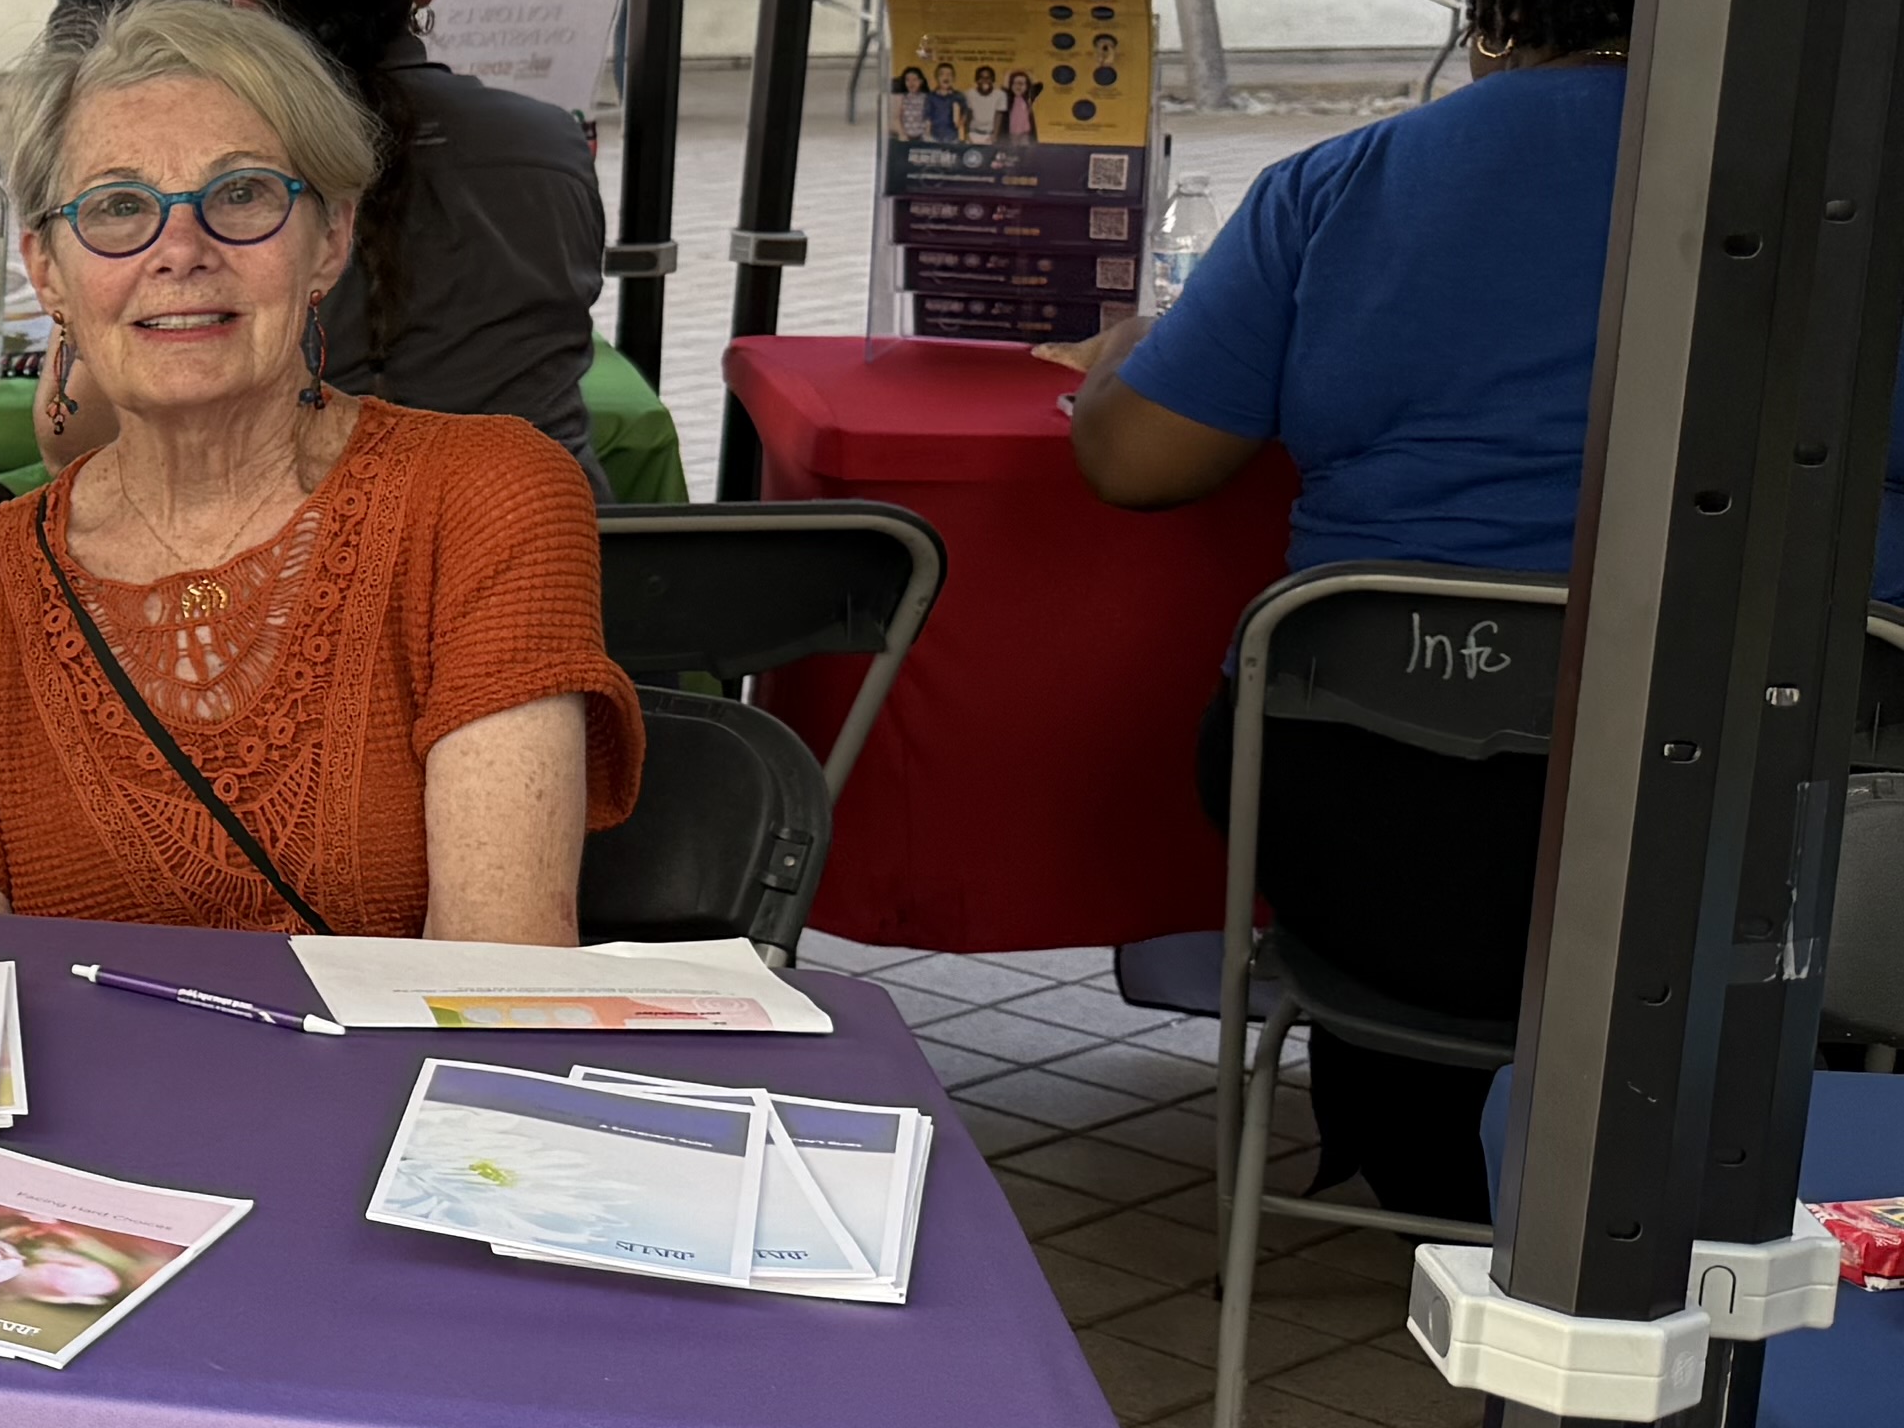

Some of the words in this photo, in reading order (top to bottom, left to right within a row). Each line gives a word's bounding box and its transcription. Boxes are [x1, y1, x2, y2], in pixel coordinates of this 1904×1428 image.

[1405, 612, 1512, 681] Info
[16, 1191, 67, 1209] Facing
[72, 1204, 109, 1218] Hard
[112, 1214, 174, 1232] Choices
[754, 1250, 808, 1261] ARP
